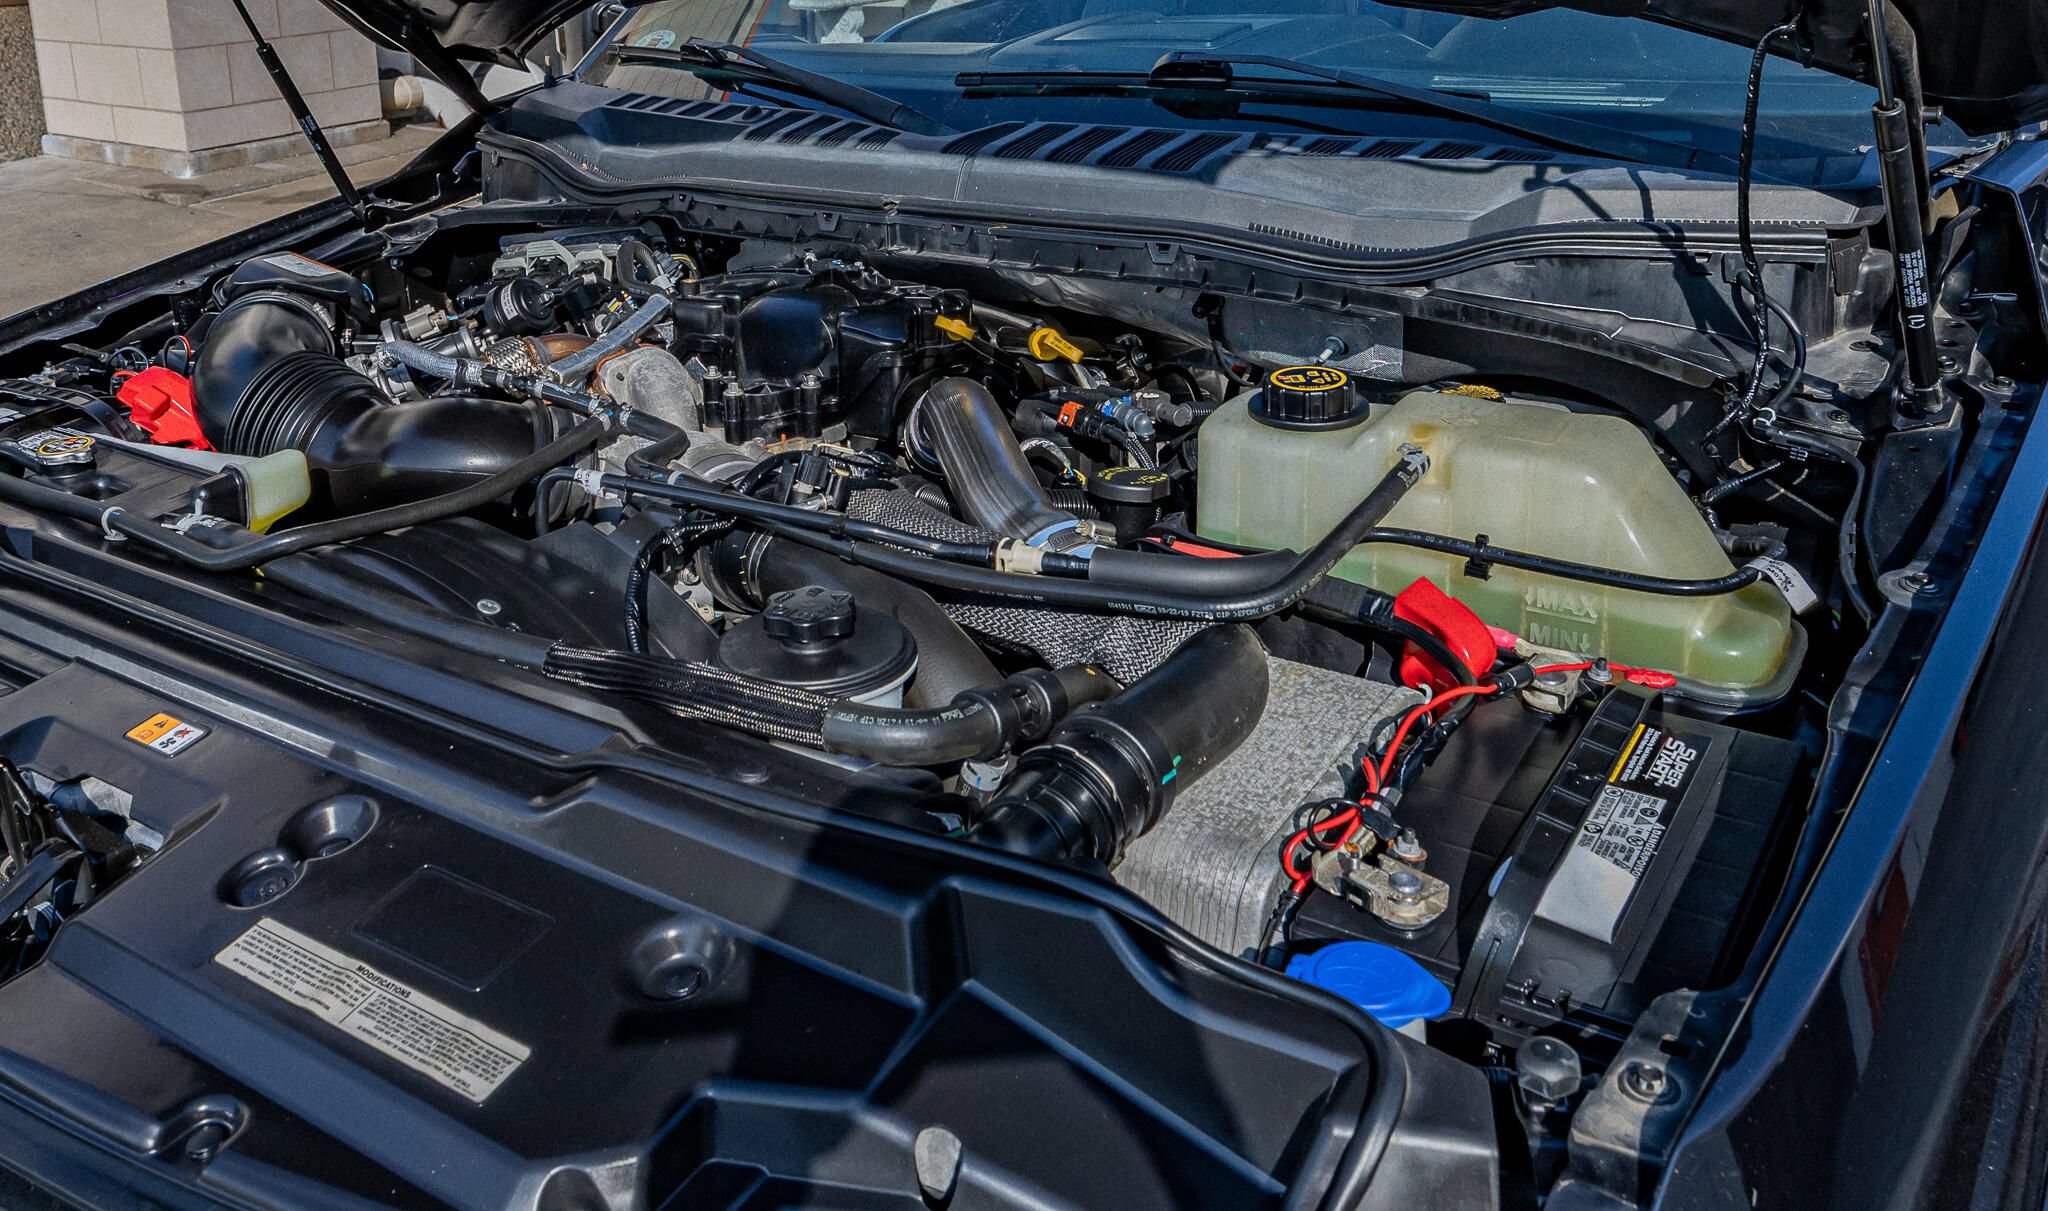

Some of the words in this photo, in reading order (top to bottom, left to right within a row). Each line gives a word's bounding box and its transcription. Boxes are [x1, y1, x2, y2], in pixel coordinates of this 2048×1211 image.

[1536, 586, 1598, 618] MAX
[1529, 622, 1578, 651] MIN
[1649, 736, 1686, 786] START
[1664, 746, 1697, 788] SUPER
[355, 965, 412, 998] MODIFICATIONS
